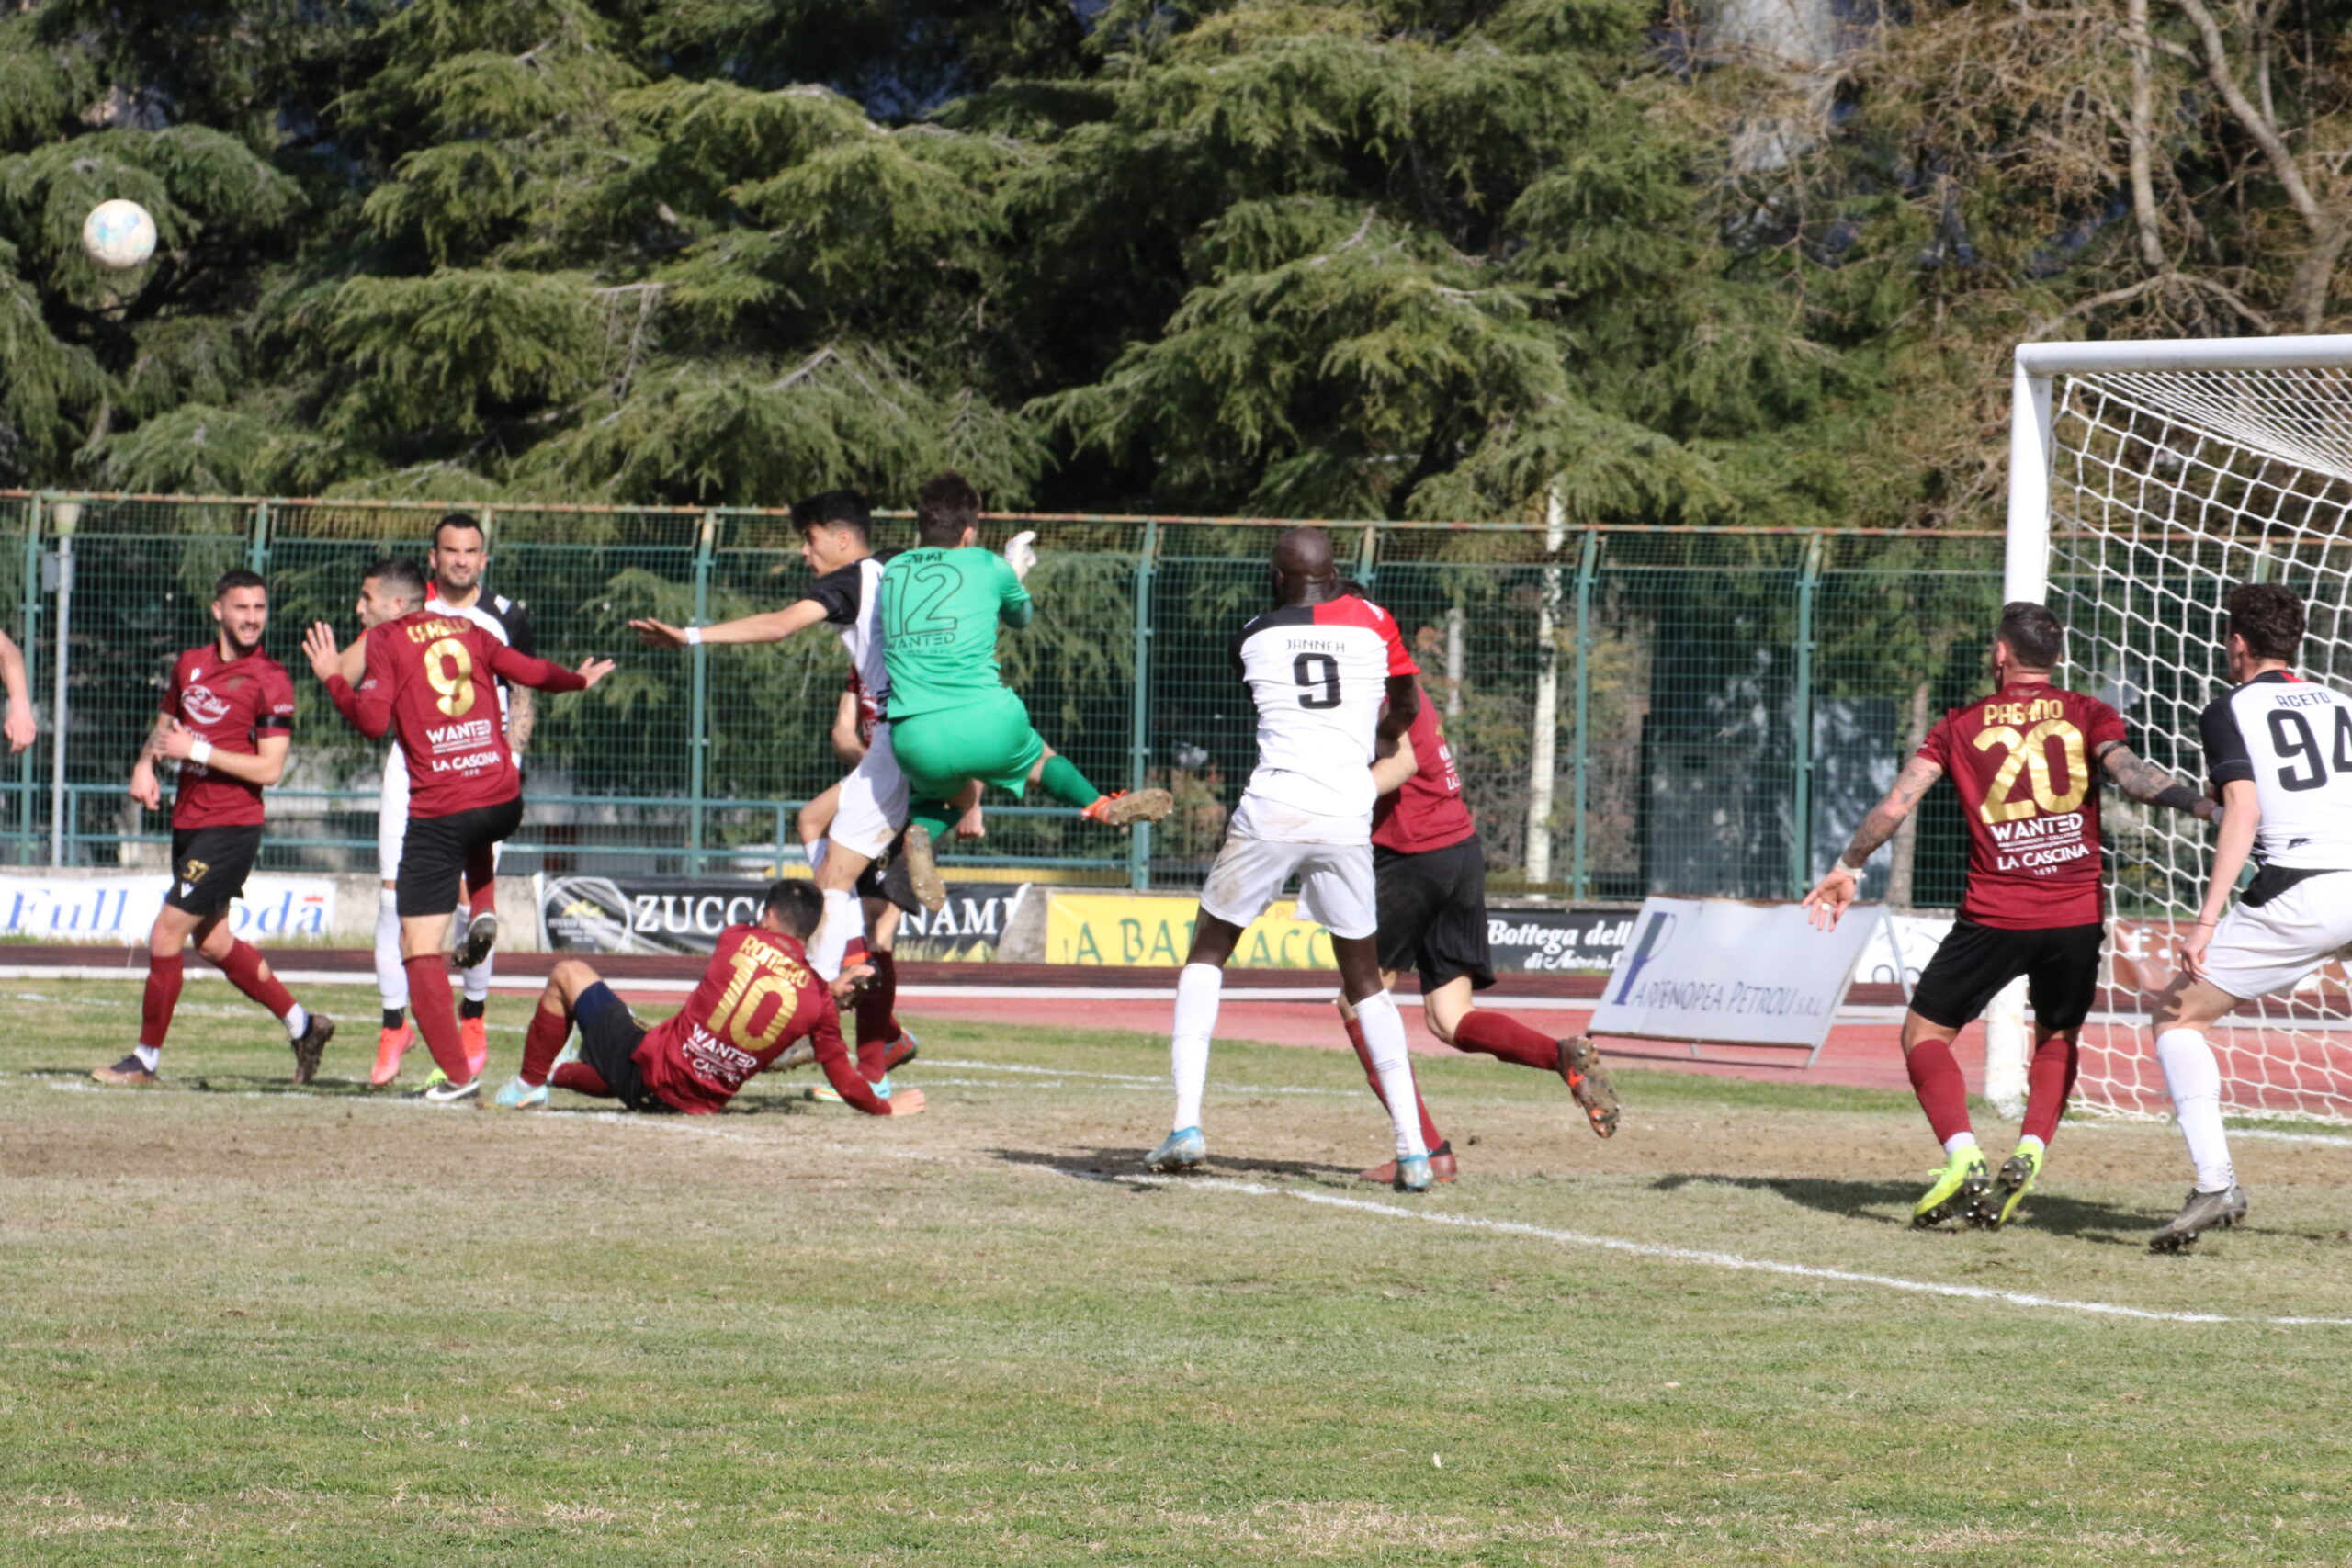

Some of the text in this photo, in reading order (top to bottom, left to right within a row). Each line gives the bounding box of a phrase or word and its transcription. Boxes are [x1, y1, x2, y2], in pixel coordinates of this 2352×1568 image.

[884, 563, 963, 639] 12
[887, 632, 956, 650] WANTED
[424, 638, 475, 717] 9
[1293, 652, 1342, 709] 9
[426, 719, 492, 744] WANTED
[432, 750, 501, 772] LA CASCINA
[1973, 718, 2089, 824] 20
[1990, 812, 2084, 841] WANTED
[1996, 855, 2020, 871] LA
[2022, 843, 2091, 867] CASCINA
[6, 888, 324, 933] Full oda
[1487, 919, 1579, 955] Bottega
[707, 952, 798, 1052] 10
[692, 1022, 758, 1068] WANTED
